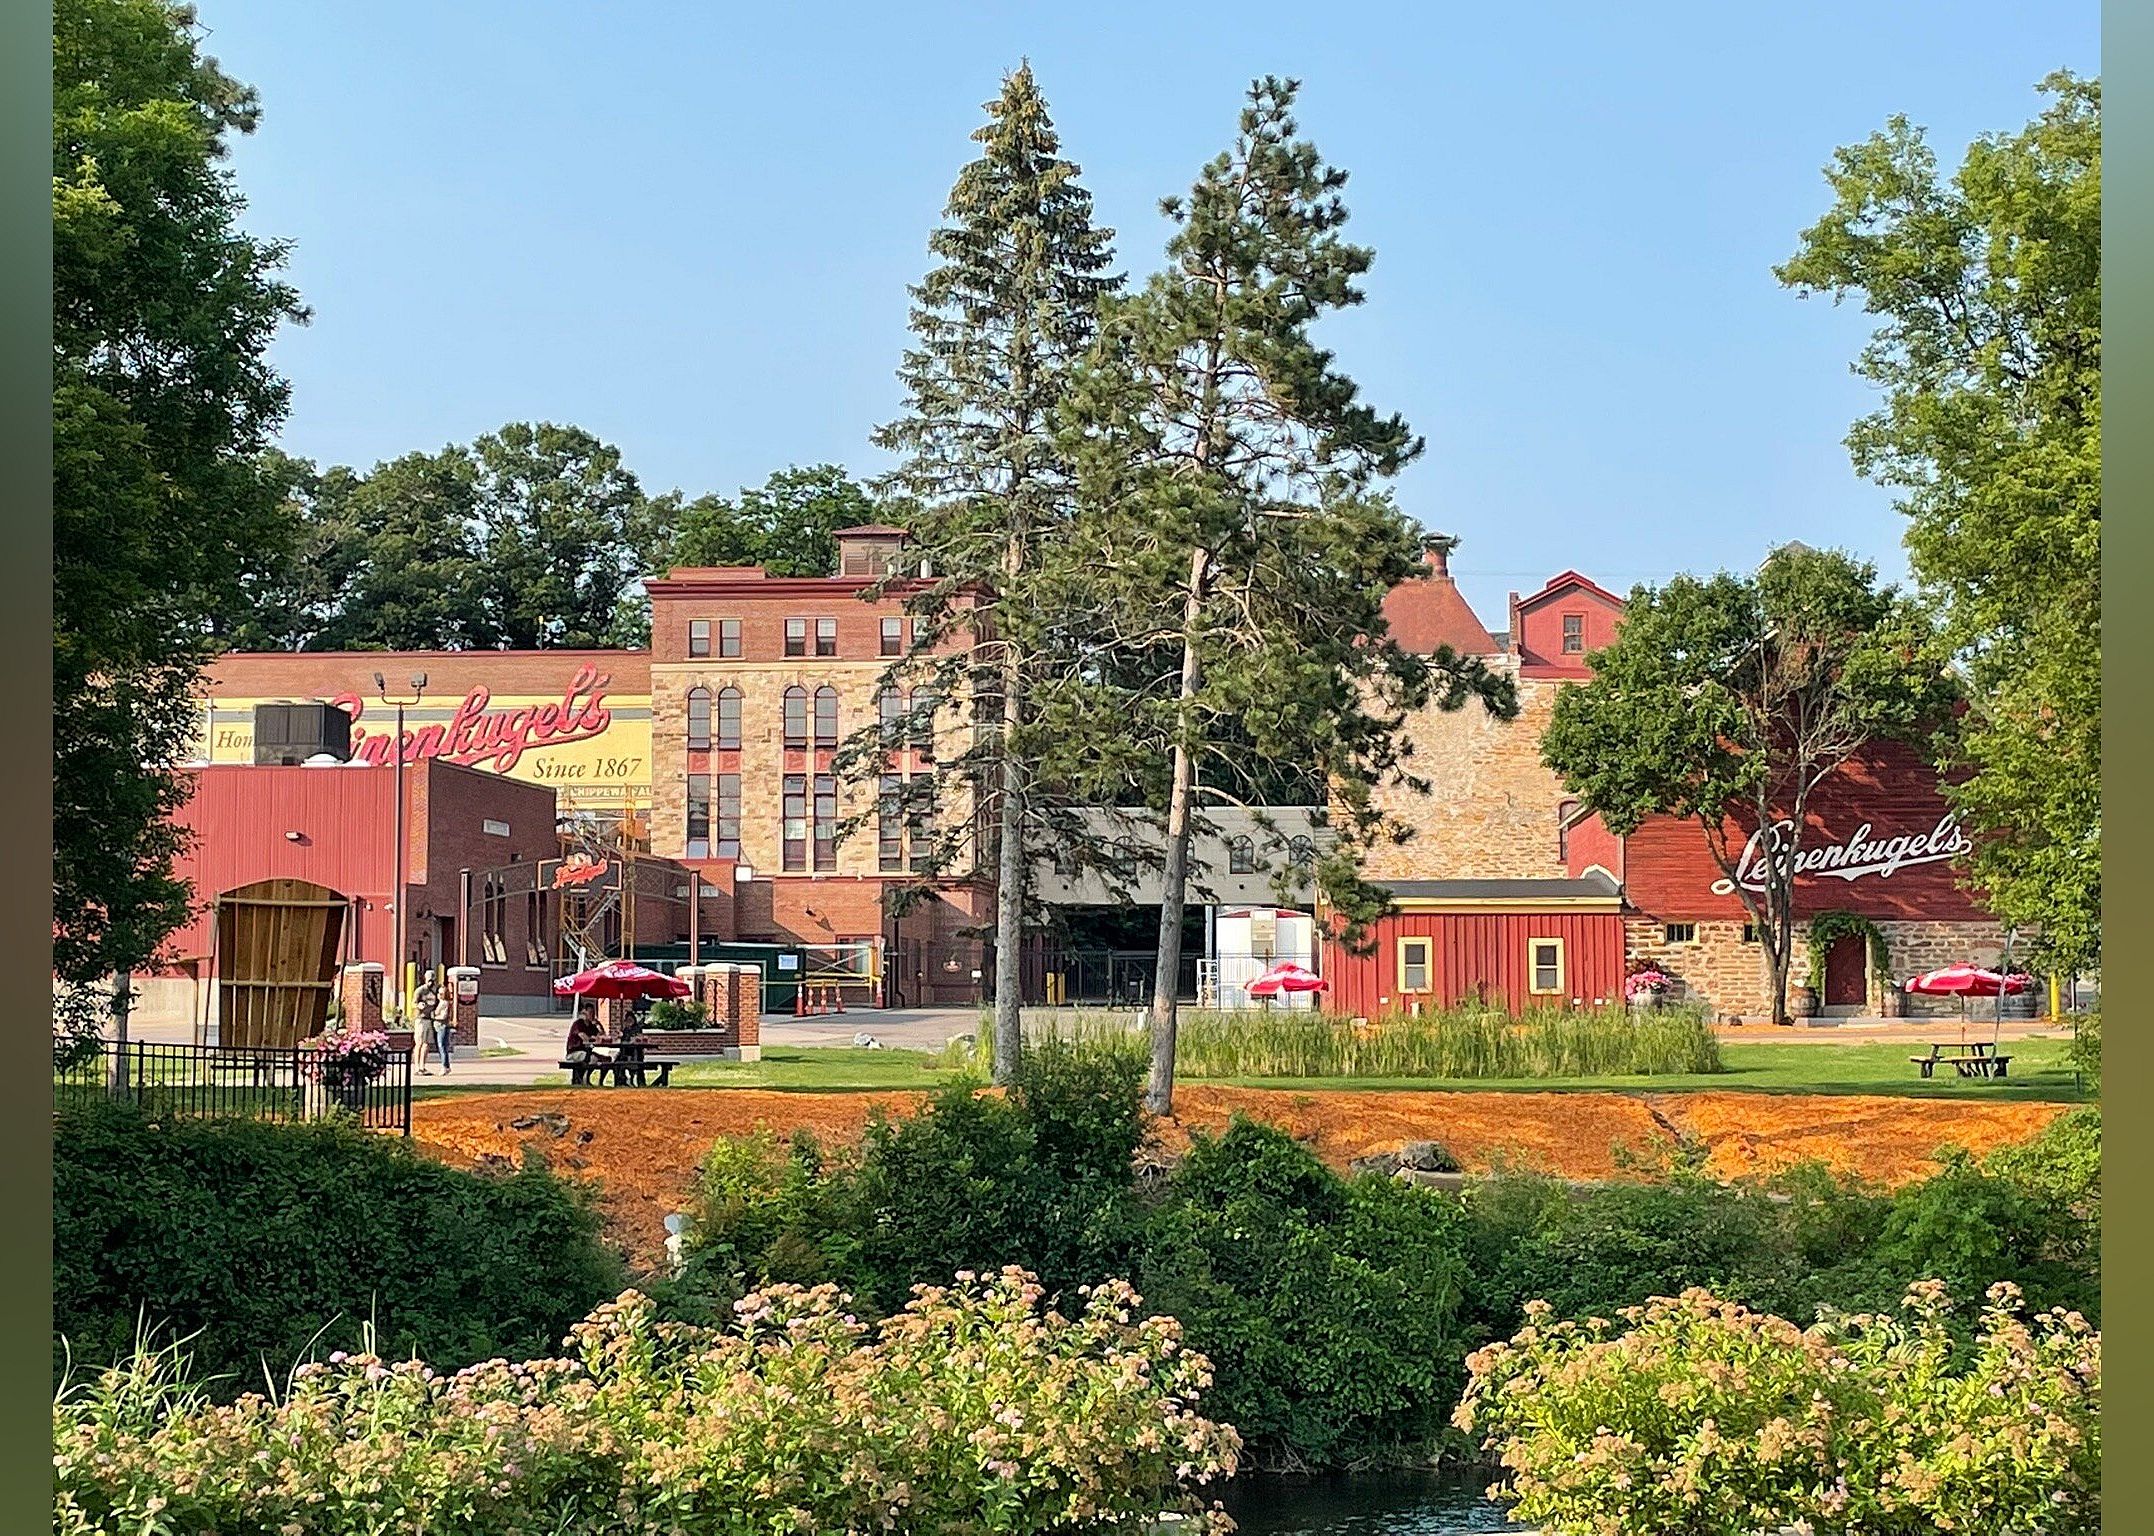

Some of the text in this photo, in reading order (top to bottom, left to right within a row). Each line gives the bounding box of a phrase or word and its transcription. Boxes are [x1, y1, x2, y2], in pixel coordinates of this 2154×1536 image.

[331, 661, 612, 774] inenkugel's
[533, 757, 642, 778] Since 1867
